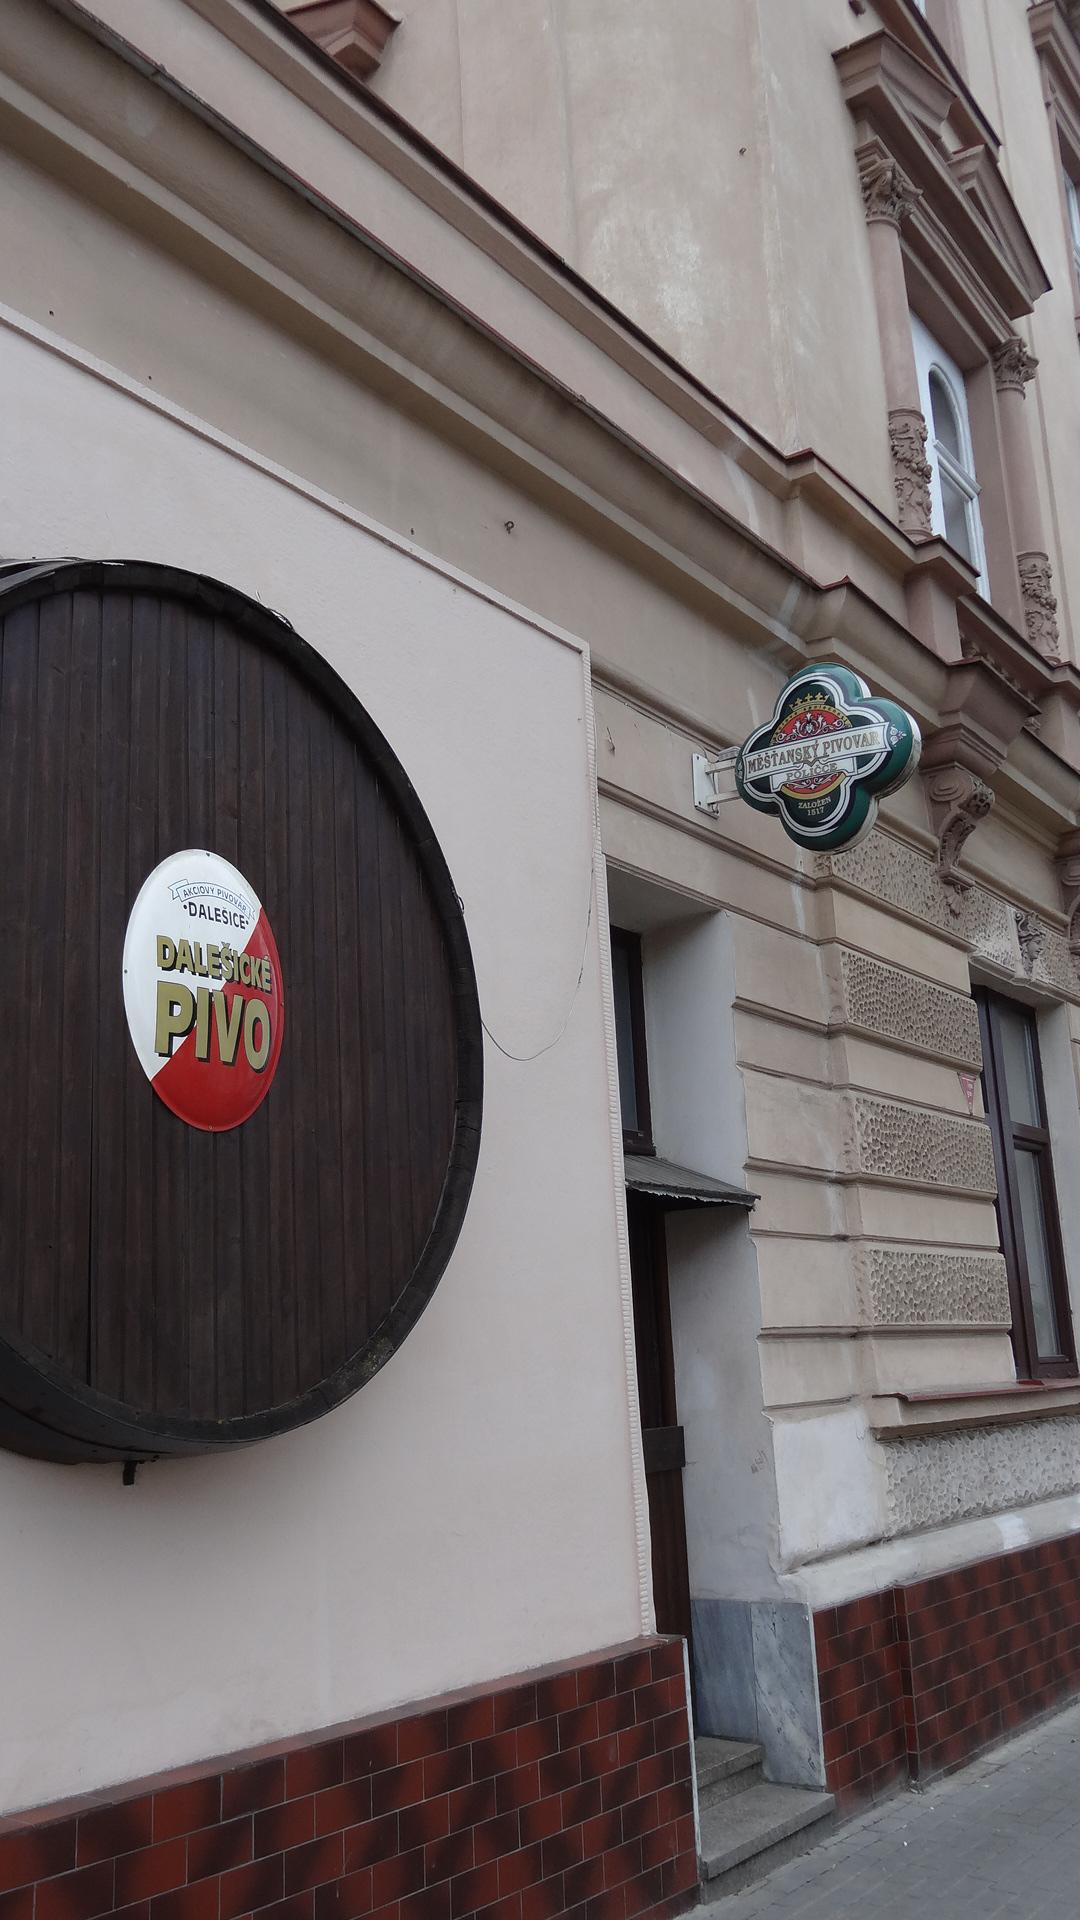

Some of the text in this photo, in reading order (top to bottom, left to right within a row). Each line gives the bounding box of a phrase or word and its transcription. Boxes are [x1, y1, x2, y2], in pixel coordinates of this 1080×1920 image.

[747, 731, 880, 774] MĚŠŤANSKÝ PIVOVAR
[786, 762, 838, 781] POLIČCE
[217, 888, 247, 913] PIVOVAR
[156, 934, 272, 993] DALEŠICKÉ
[155, 980, 271, 1074] PIVO
